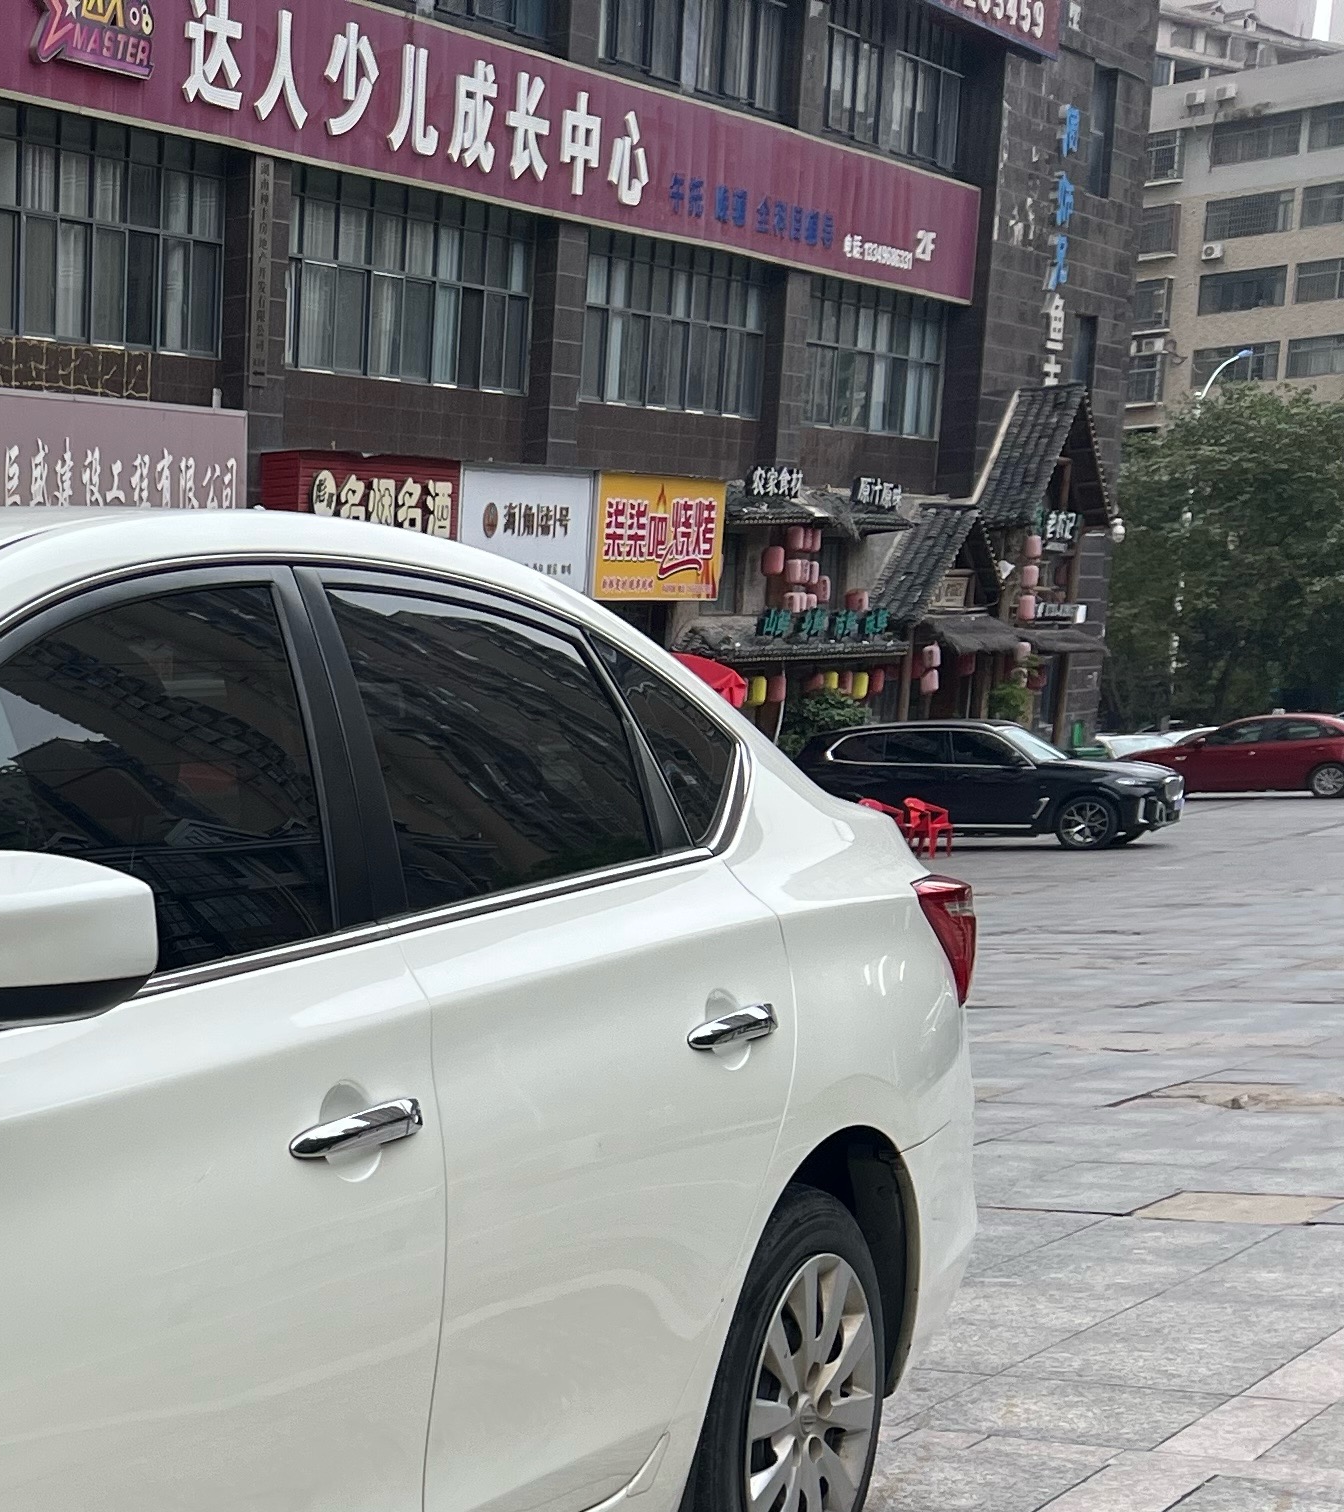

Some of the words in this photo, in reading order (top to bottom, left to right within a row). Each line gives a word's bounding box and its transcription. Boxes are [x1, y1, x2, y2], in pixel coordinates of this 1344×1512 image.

[72, 22, 152, 66] MASTER
[181, 0, 650, 207] 达人少儿成长中心
[915, 229, 937, 262] 2F
[340, 474, 453, 538] 名烟名酒
[752, 466, 803, 498] 农家食材
[602, 498, 718, 581] 柒柒吧烧烤
